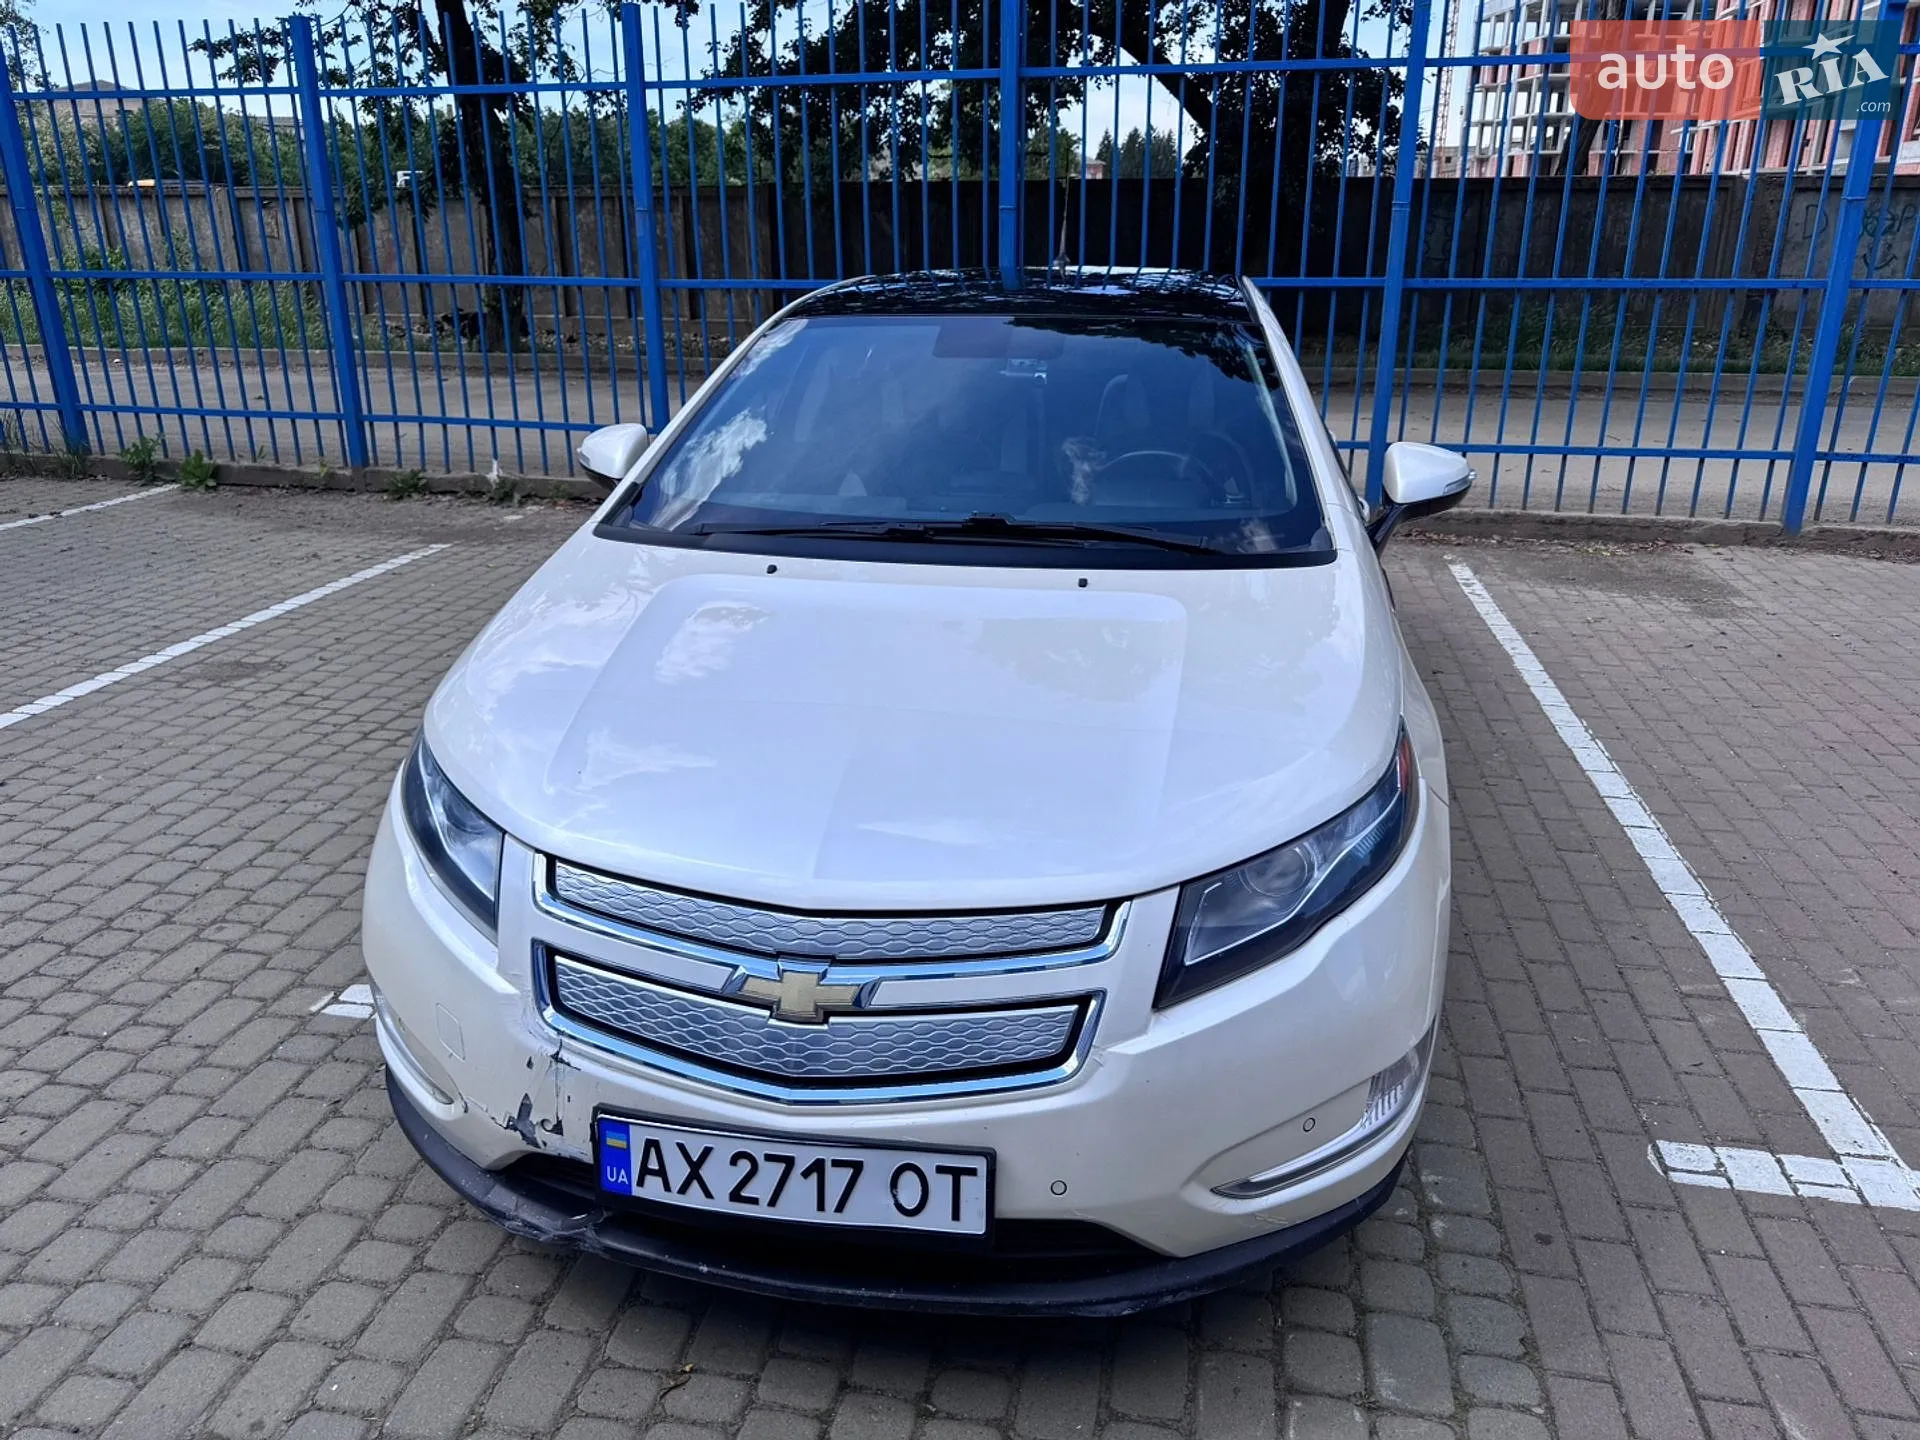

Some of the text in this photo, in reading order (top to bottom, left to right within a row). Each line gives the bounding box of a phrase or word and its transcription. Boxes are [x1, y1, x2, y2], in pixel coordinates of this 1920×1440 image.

[606, 1166, 629, 1185] UA
[636, 1138, 978, 1222] AX 2717 OT
